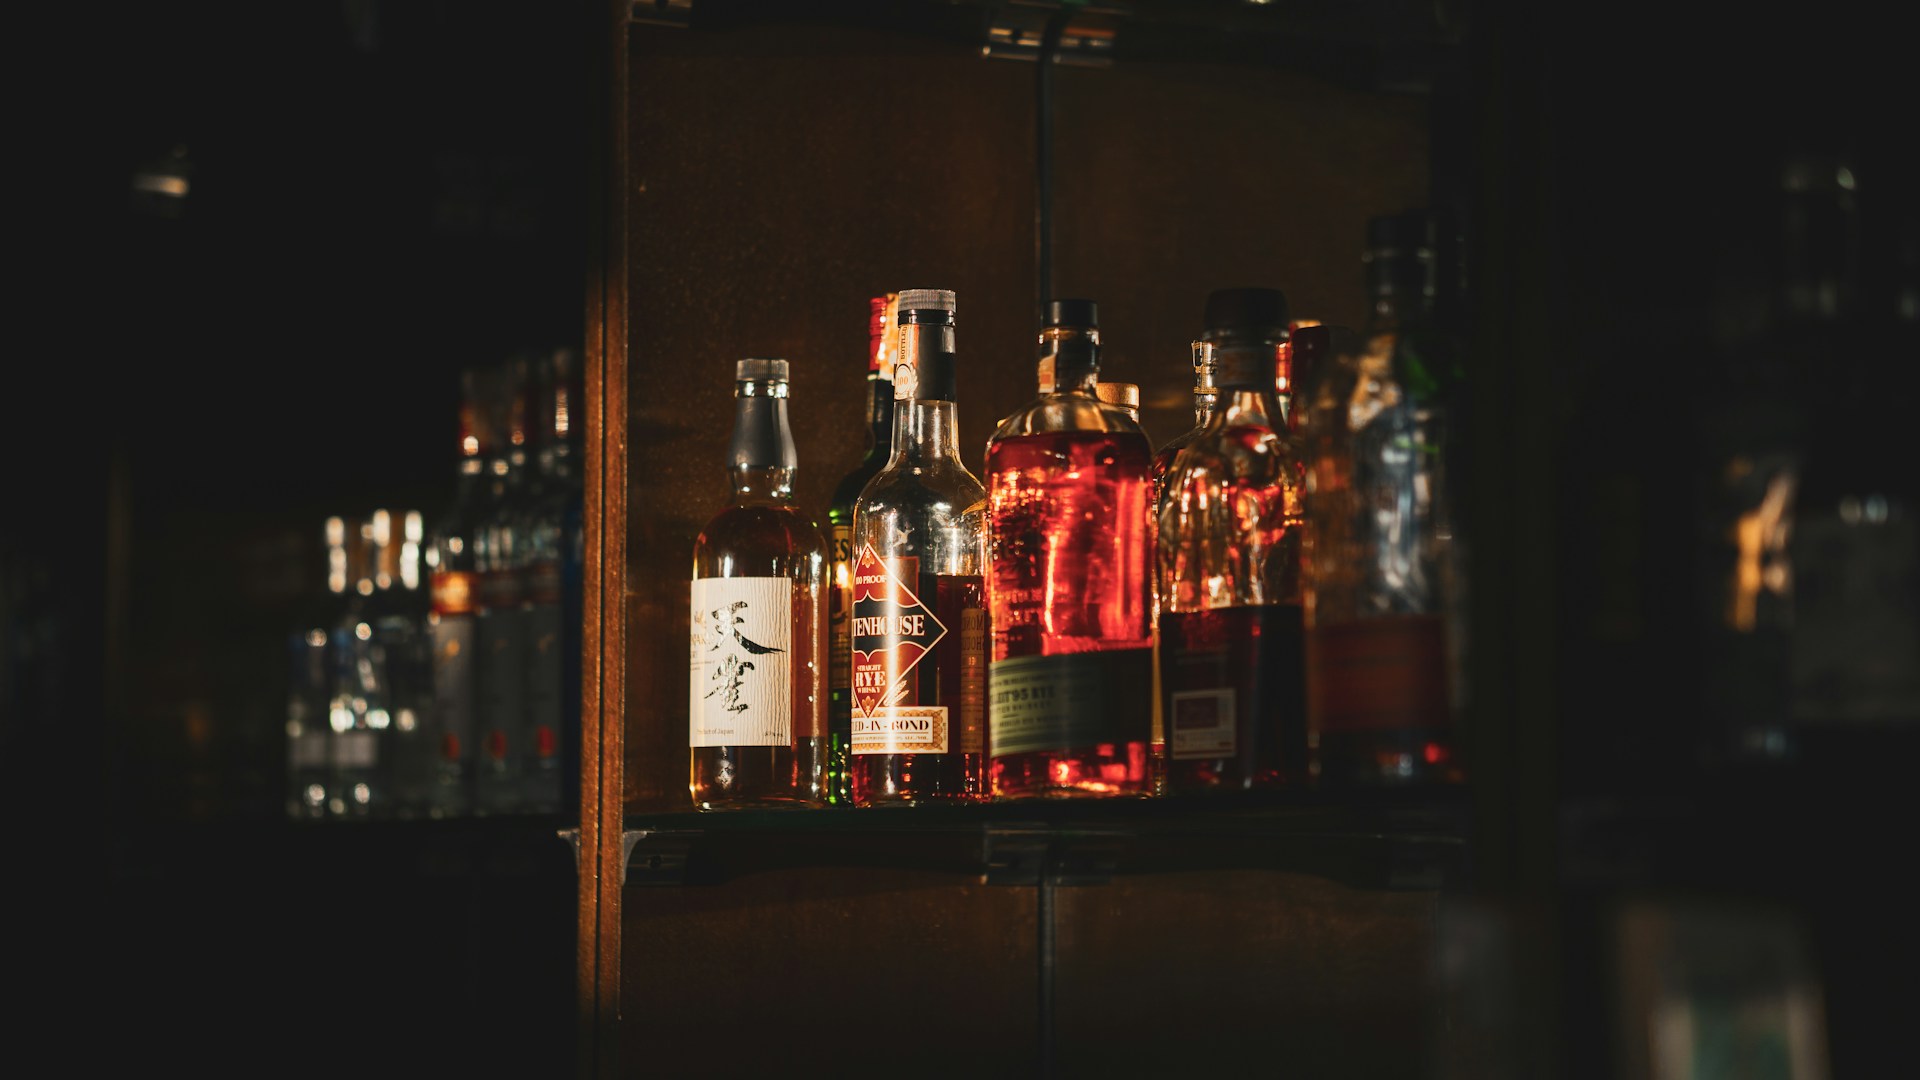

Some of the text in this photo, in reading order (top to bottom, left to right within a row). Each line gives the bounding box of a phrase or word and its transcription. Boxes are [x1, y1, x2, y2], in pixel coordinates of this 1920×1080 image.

[863, 575, 888, 584] PROOF
[855, 671, 886, 687] RYE
[857, 686, 881, 694] WHISKY
